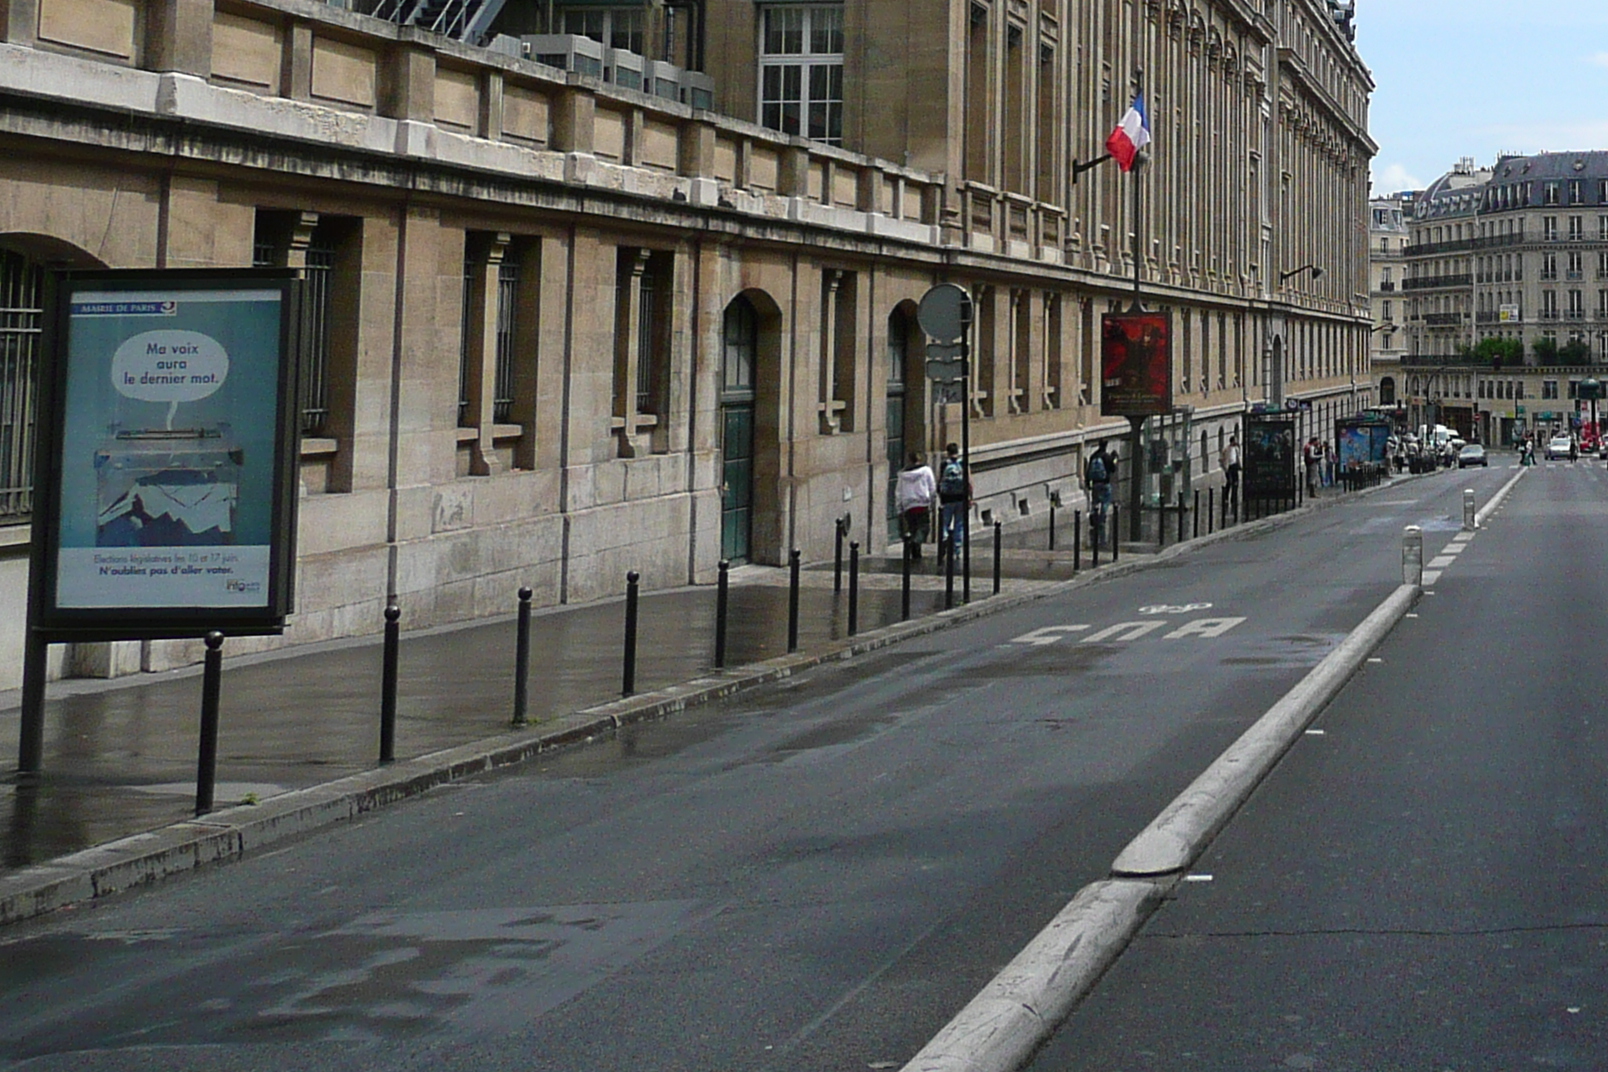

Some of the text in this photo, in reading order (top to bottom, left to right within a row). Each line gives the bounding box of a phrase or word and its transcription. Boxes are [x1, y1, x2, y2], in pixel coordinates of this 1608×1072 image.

[116, 304, 127, 312] DE
[131, 304, 156, 312] PARIS
[146, 342, 199, 355] Ma voix
[157, 360, 187, 370] aura
[124, 372, 219, 384] le dernier mot.
[130, 553, 172, 565] législatives
[211, 553, 220, 561] 17
[150, 568, 168, 577] pas
[171, 564, 203, 574] d'aller
[206, 566, 233, 574] voter.
